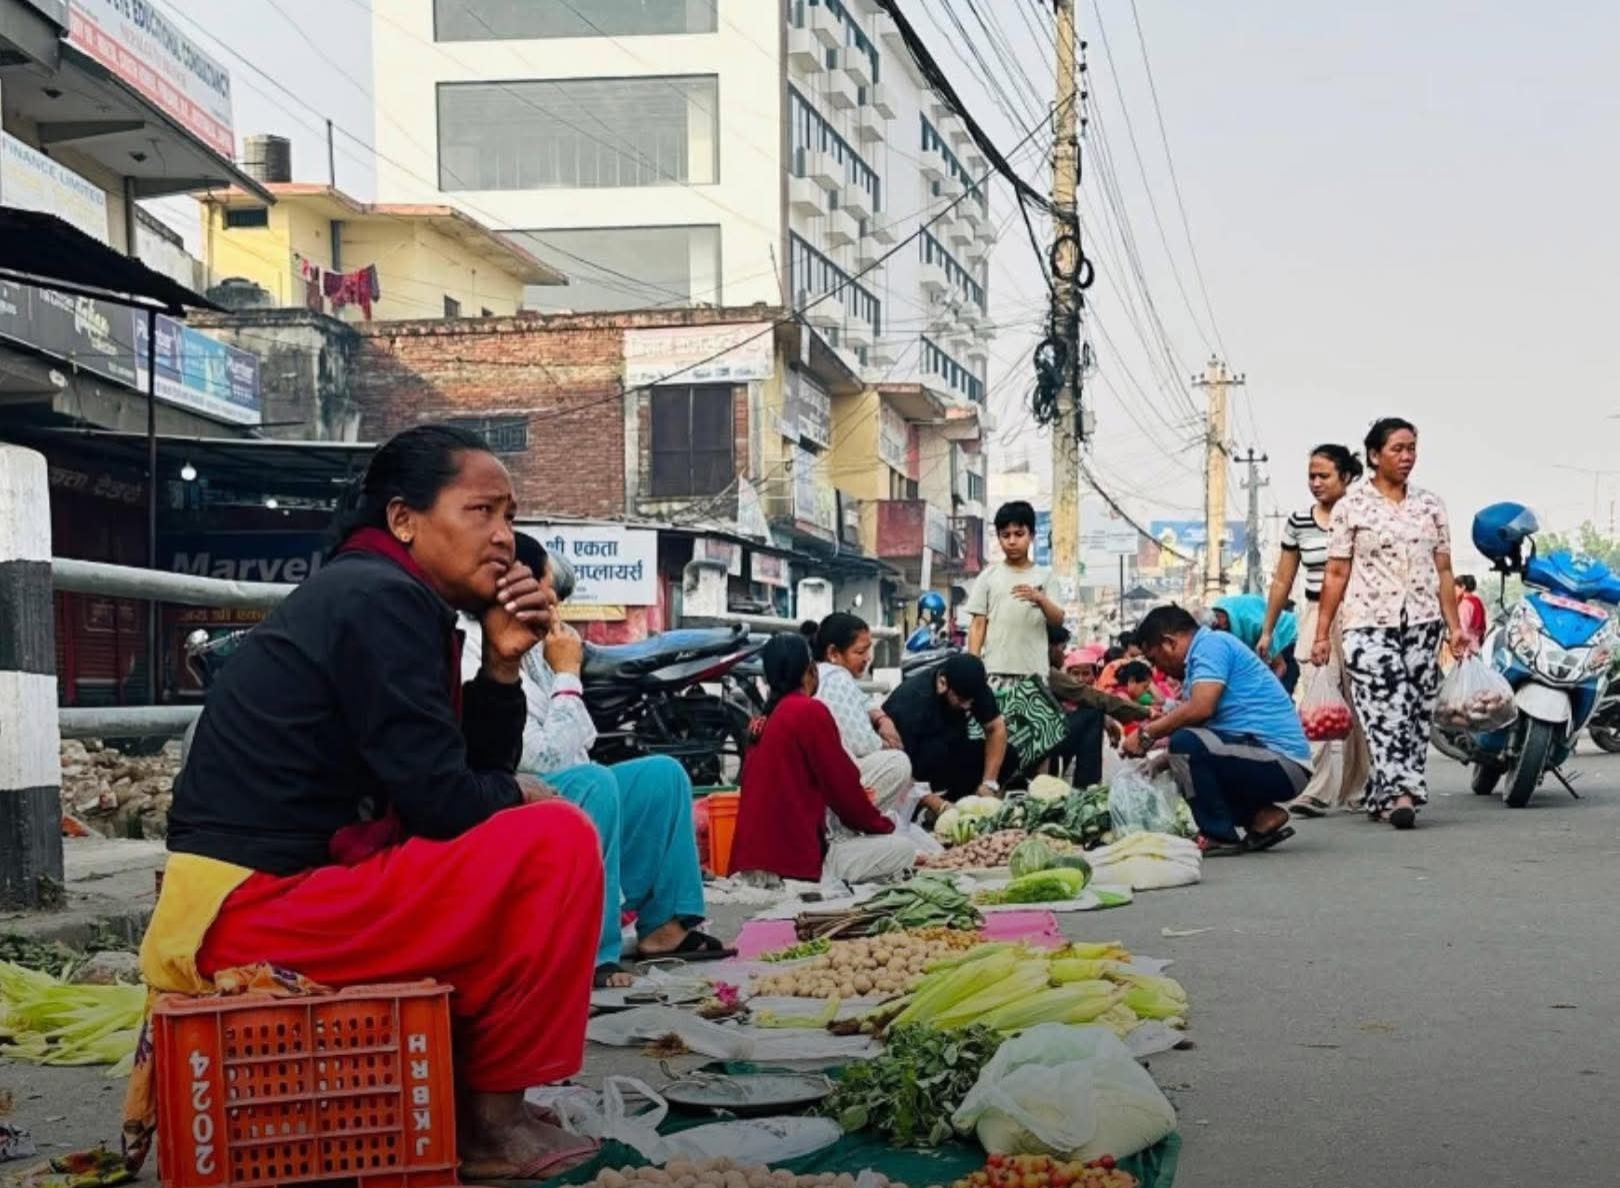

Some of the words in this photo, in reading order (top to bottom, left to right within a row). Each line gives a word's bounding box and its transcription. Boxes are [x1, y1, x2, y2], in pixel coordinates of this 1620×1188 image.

[60, 170, 104, 206] LIMITED
[573, 541, 618, 557] एकता
[173, 552, 323, 582] Marvel
[573, 559, 642, 581] सप्लायर्स
[189, 1050, 216, 1175] 2024
